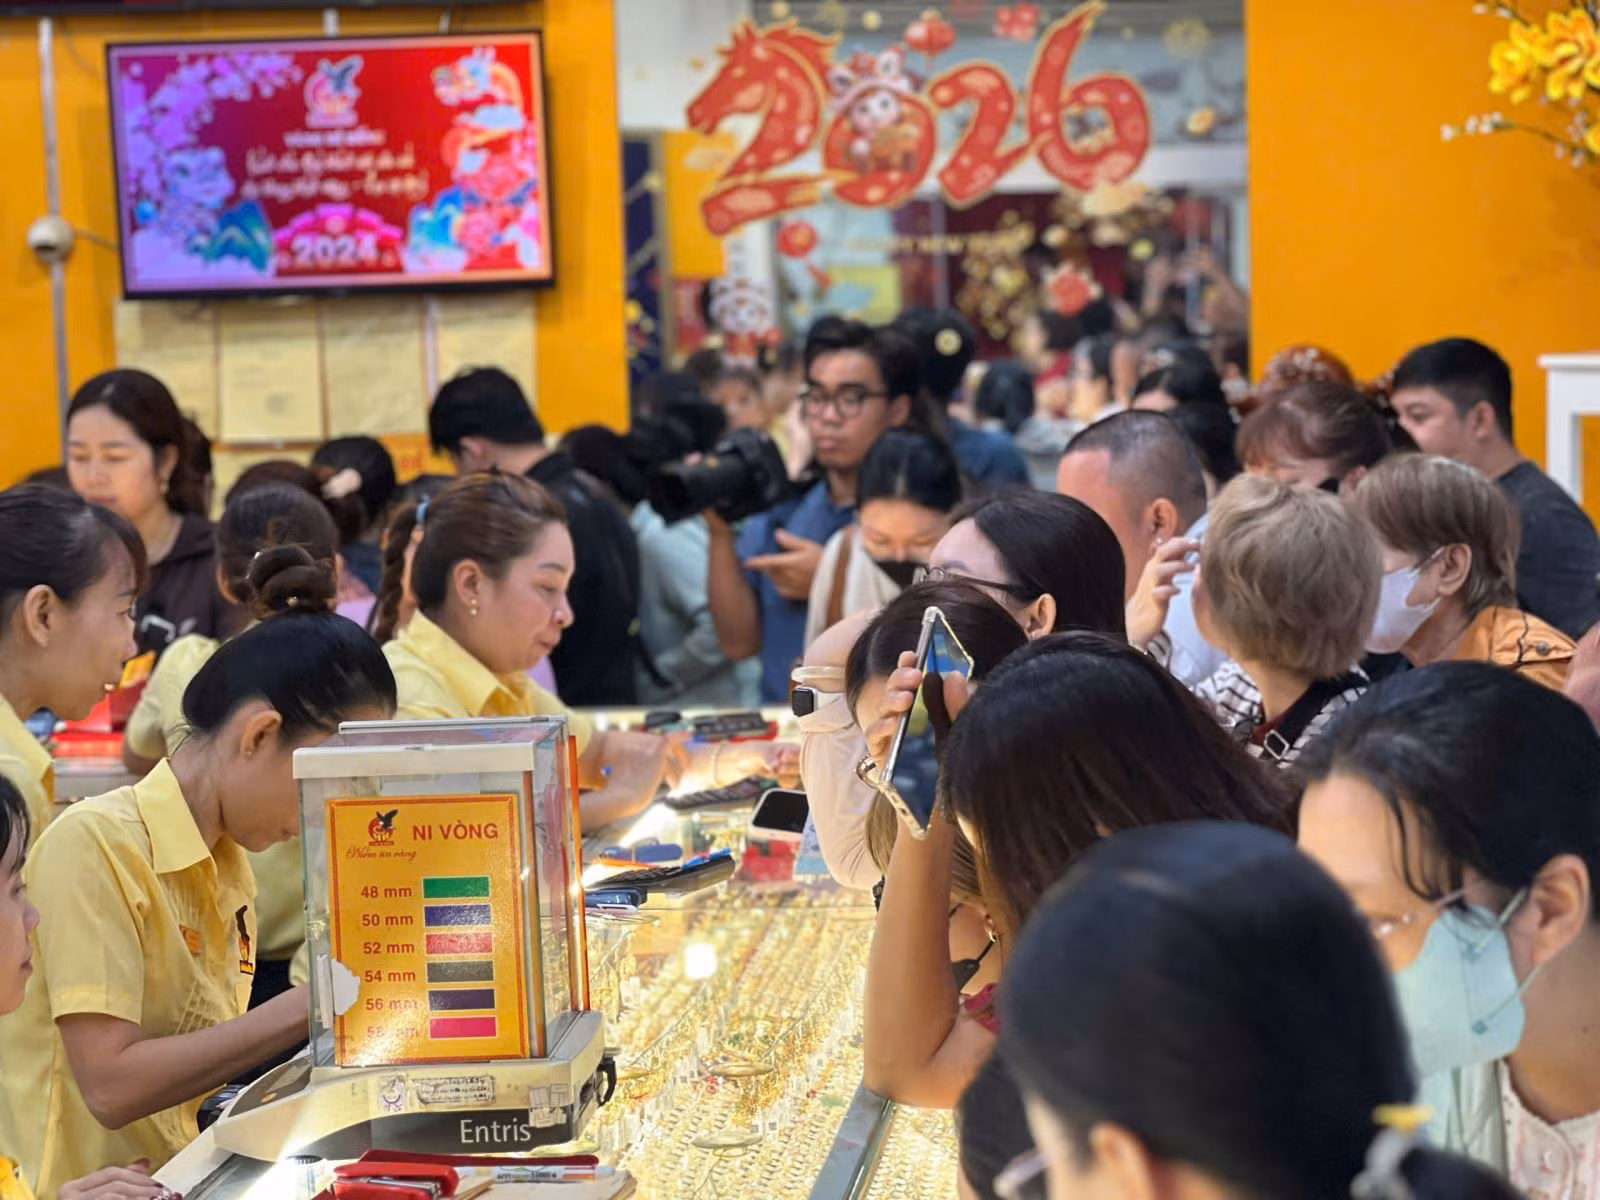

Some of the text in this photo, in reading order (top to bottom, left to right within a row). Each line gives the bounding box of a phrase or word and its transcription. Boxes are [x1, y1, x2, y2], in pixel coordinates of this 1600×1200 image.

[686, 1, 1152, 237] 2026
[412, 819, 499, 841] NI VÒNG
[361, 886, 412, 898] 48 mm
[362, 914, 413, 926] 50 mm
[363, 942, 415, 954] 52 mm
[364, 970, 416, 983] 54 mm
[366, 998, 417, 1010] 56 mm
[460, 1118, 532, 1144] Entris
